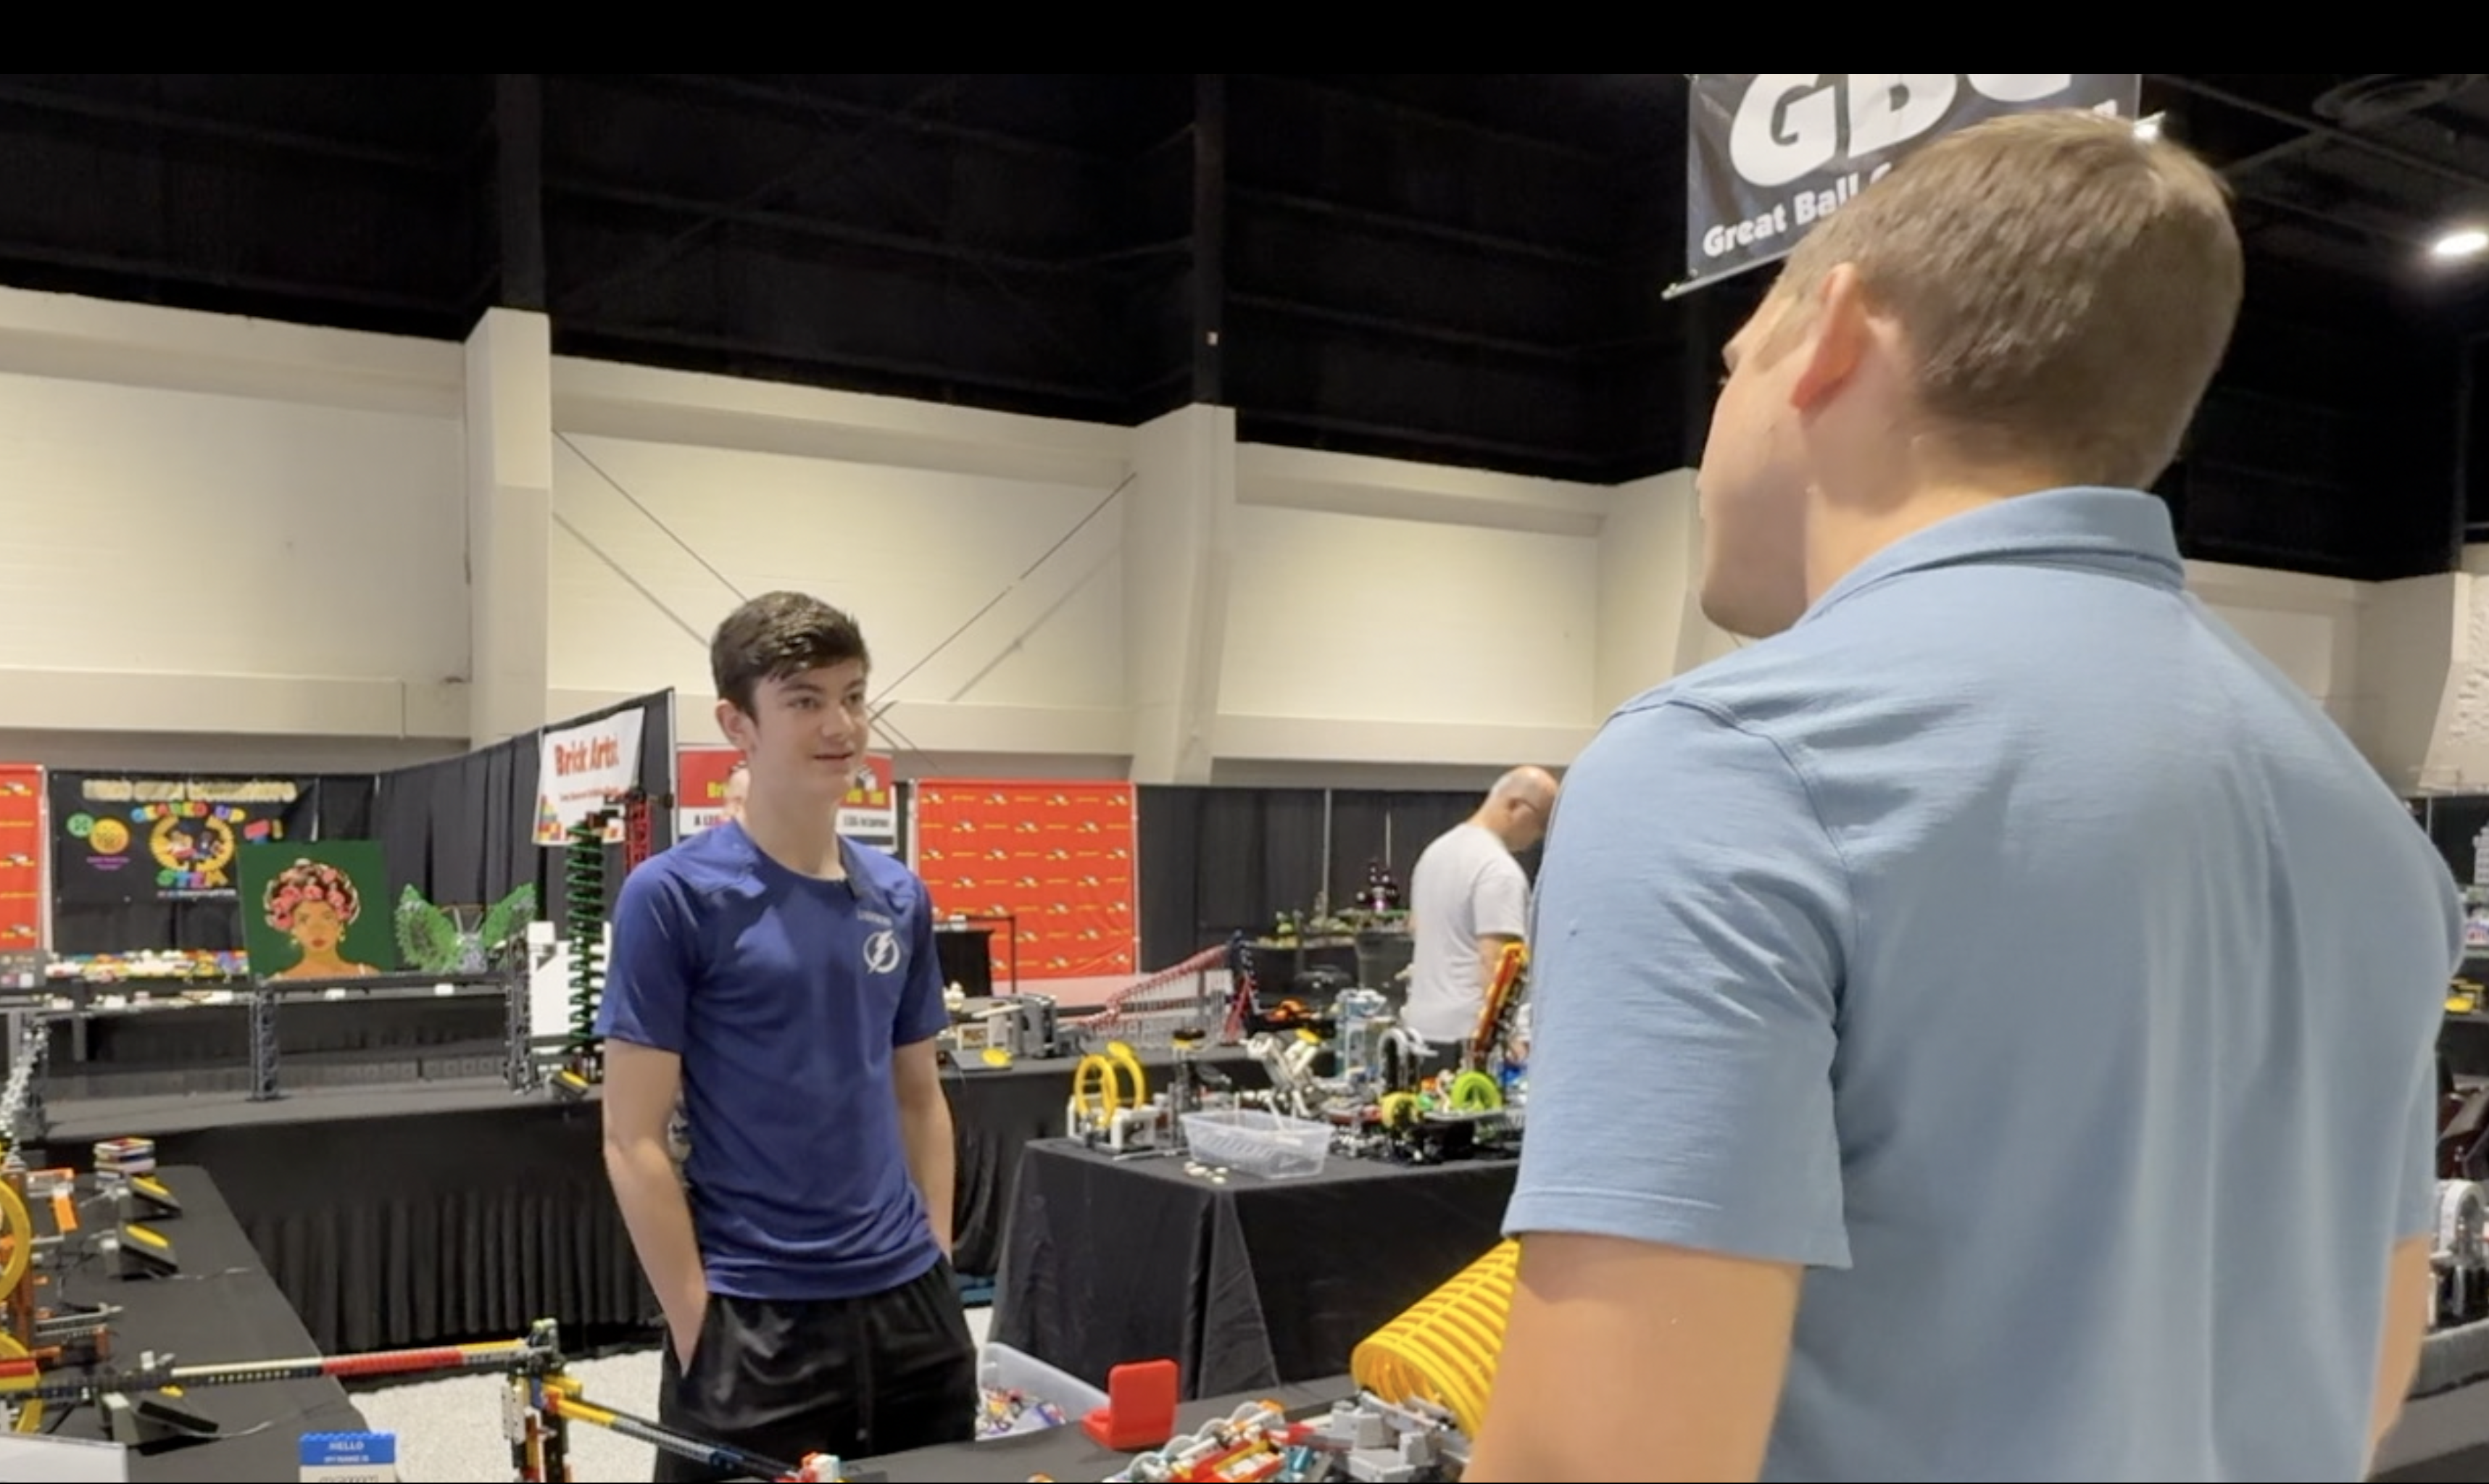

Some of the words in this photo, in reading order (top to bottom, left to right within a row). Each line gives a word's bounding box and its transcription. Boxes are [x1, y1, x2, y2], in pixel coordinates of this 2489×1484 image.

[1729, 73, 2071, 186] GB
[1703, 204, 1787, 257] Great
[1793, 172, 1859, 226] Ball
[554, 741, 588, 777] Brick
[328, 1441, 365, 1450] HELLO
